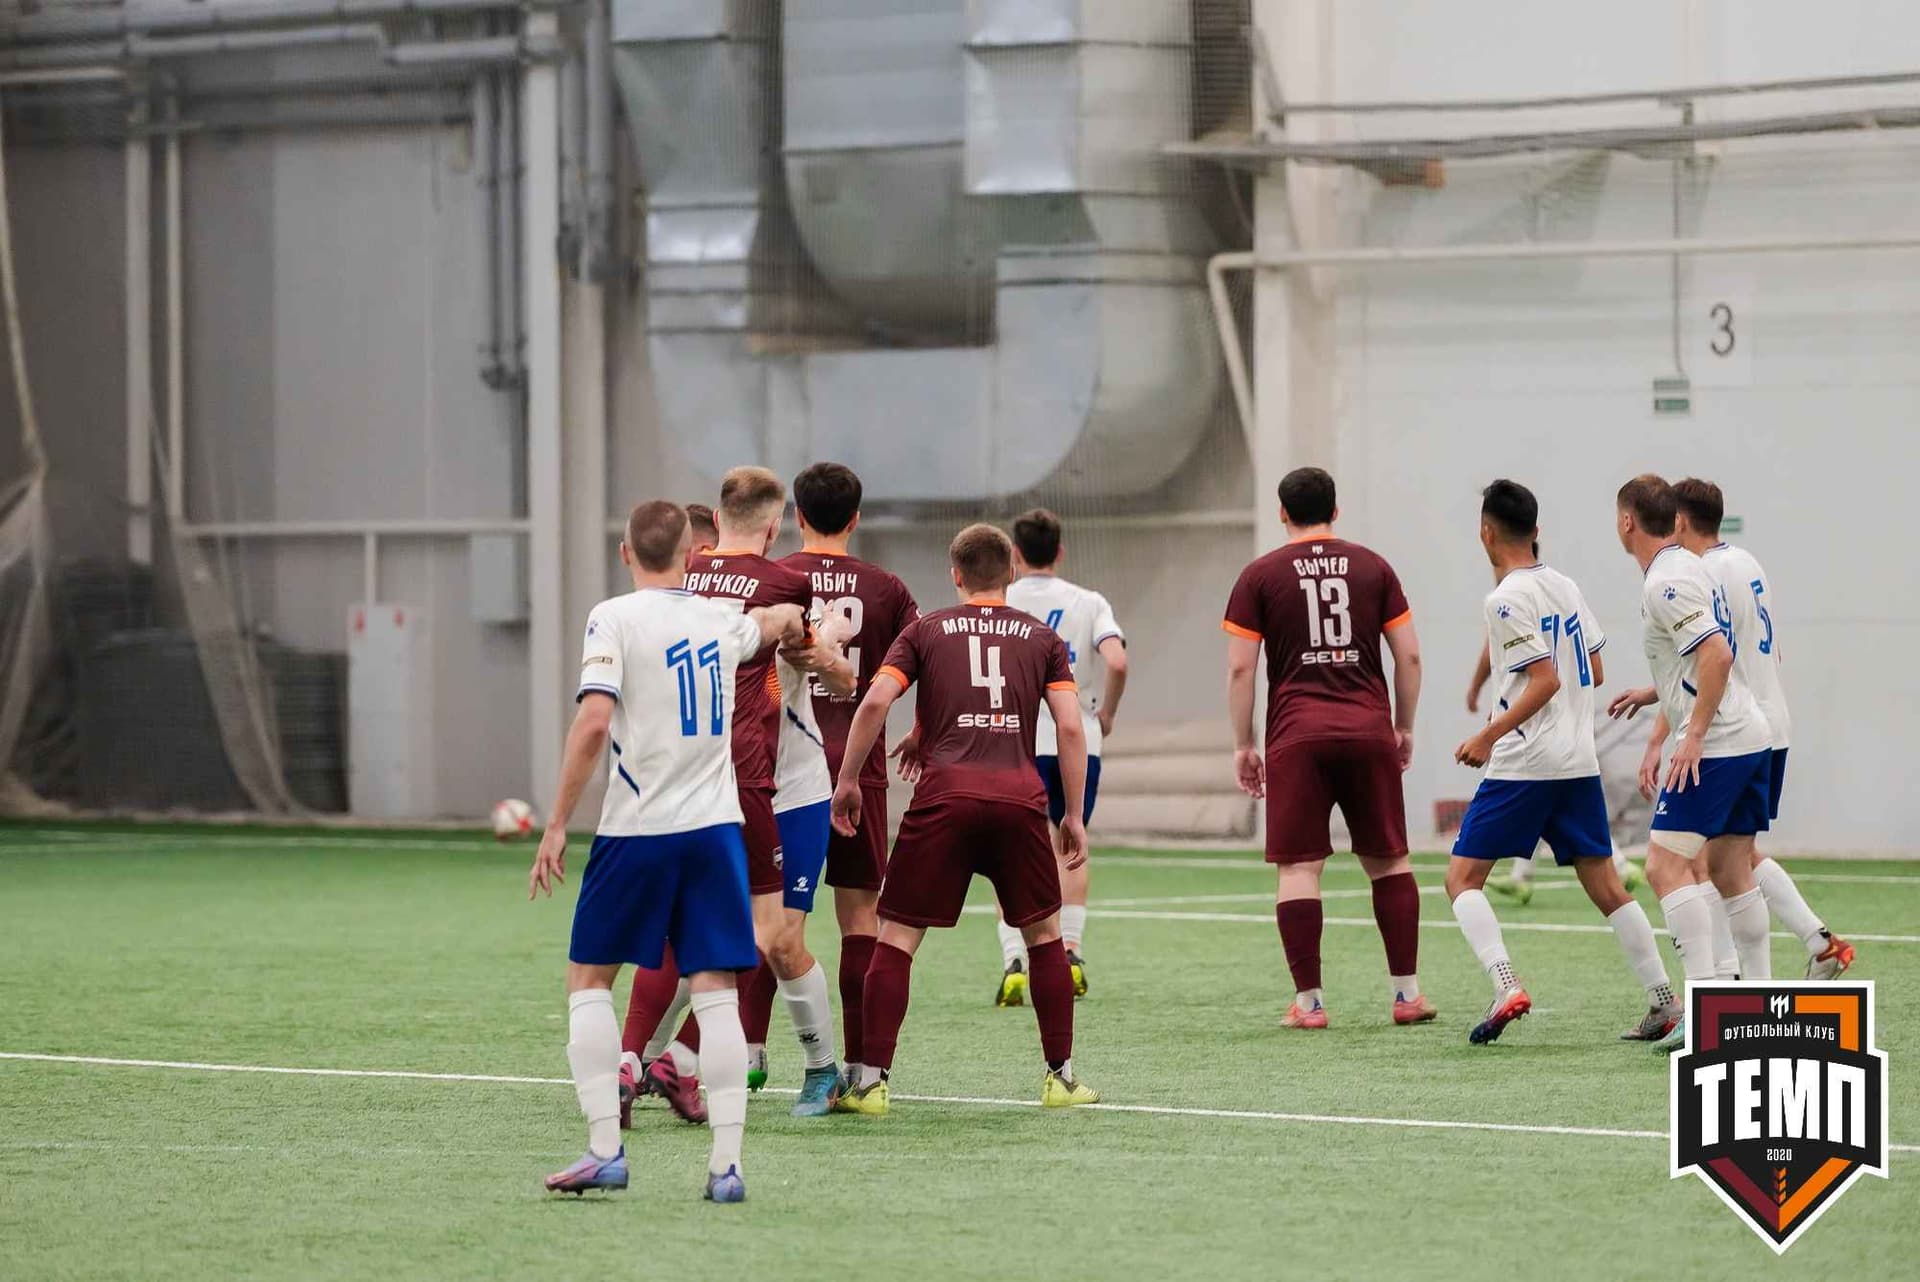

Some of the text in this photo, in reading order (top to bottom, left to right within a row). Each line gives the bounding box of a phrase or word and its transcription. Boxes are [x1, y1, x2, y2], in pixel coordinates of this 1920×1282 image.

[1709, 302, 1735, 357] 3
[804, 571, 858, 593] АБИЧ
[1293, 557, 1348, 576] СЫЧЕВ
[942, 616, 1032, 640] МАТЫЦИН
[1299, 578, 1352, 647] 13
[1750, 579, 1773, 654] 5
[968, 635, 1006, 709] 4
[1301, 650, 1359, 664] SEUS
[665, 637, 723, 737] 11
[957, 713, 1021, 728] SEUS
